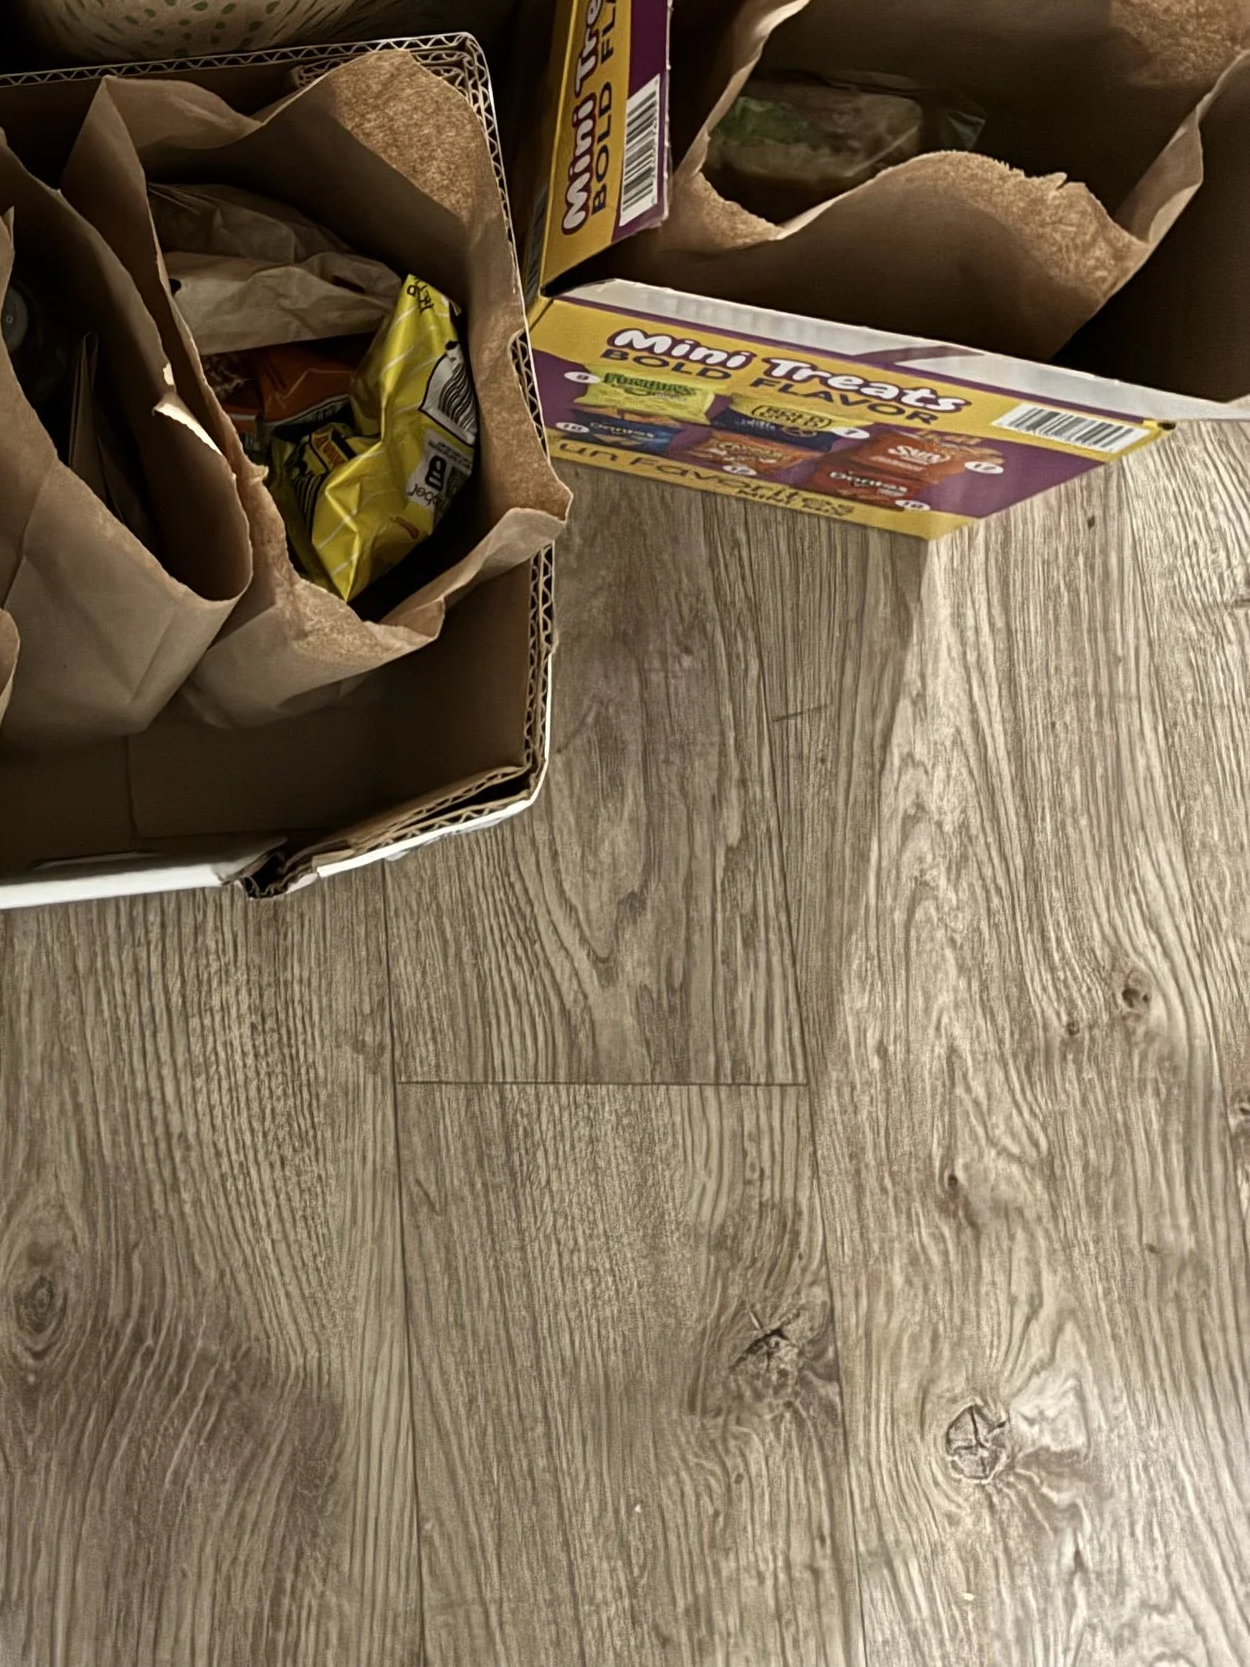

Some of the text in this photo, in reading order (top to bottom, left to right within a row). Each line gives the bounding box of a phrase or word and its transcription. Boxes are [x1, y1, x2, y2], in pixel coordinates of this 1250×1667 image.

[563, 94, 596, 233] Mini
[592, 82, 612, 215] BOLD
[601, 349, 939, 425] BOLD FLAVOR
[610, 329, 969, 412] Mini Treats
[559, 442, 618, 461] un
